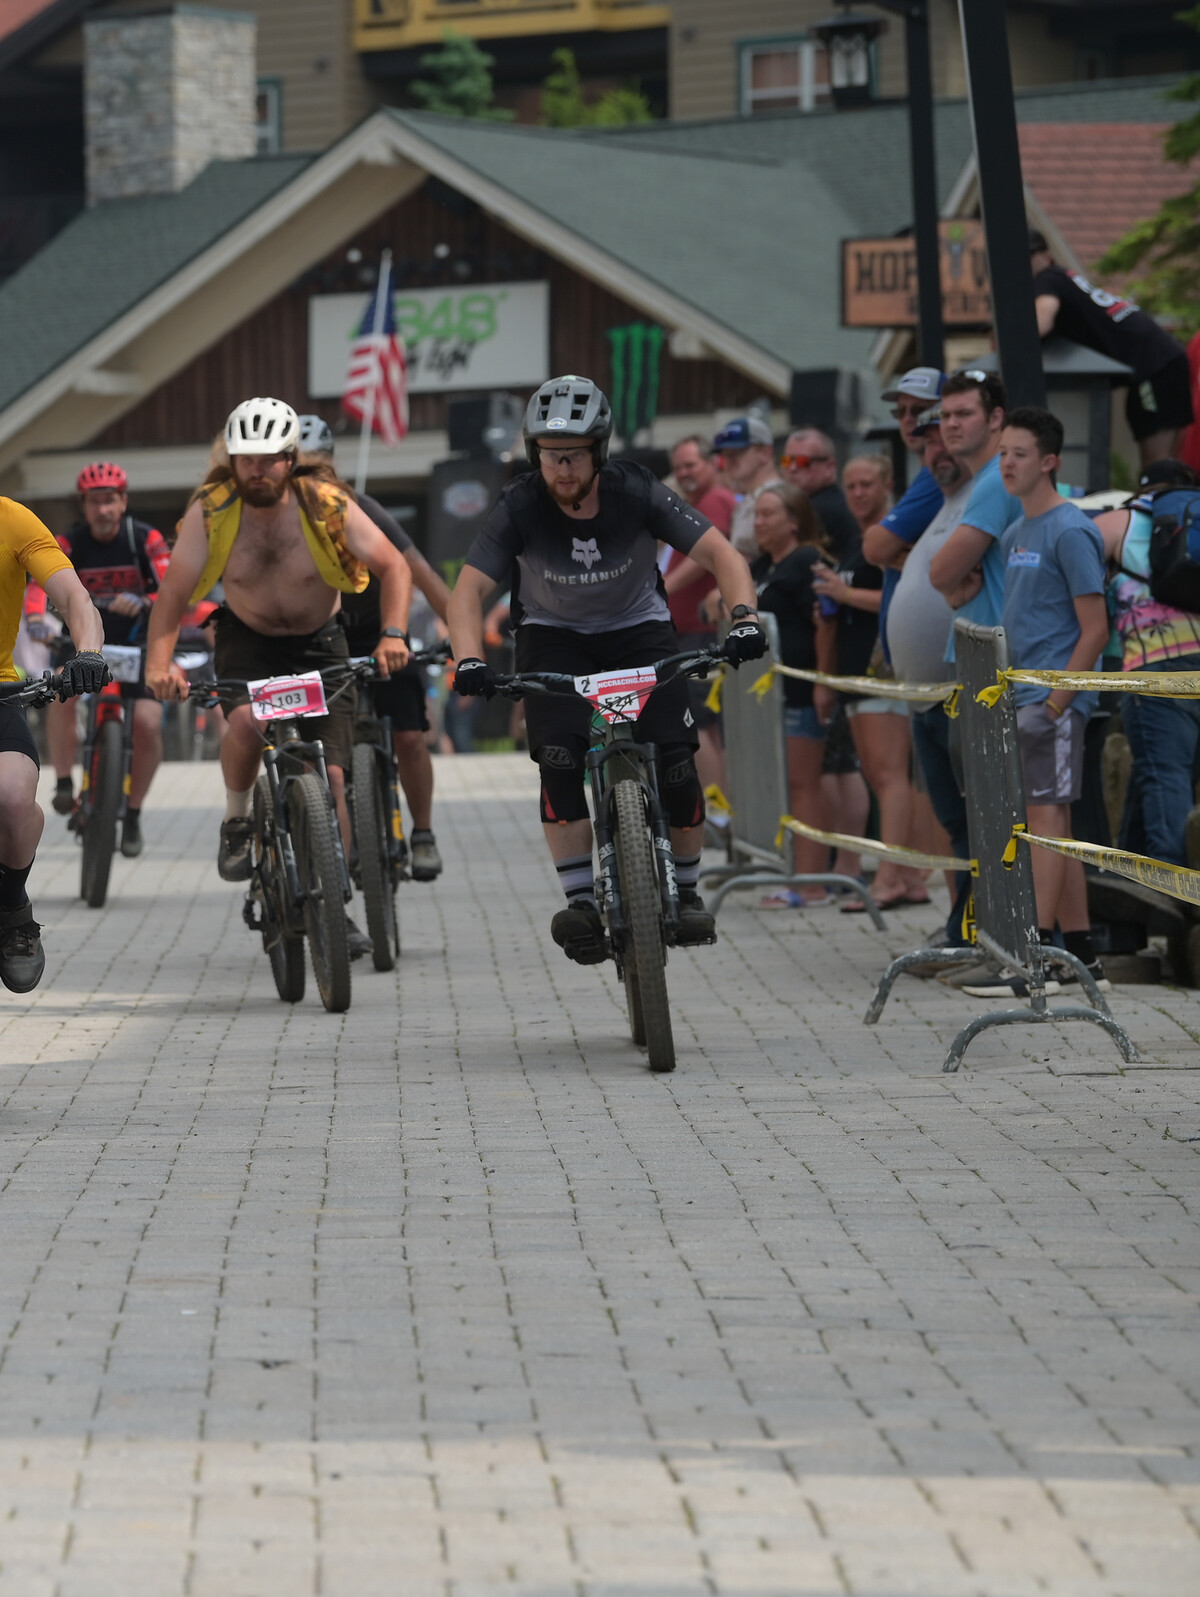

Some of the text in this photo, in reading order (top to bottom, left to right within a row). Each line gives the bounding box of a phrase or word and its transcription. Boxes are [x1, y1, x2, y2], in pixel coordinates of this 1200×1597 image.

[544, 569, 577, 585] RIDE
[277, 692, 302, 707] 103
[601, 865, 614, 903] FOX
[664, 858, 679, 897] FOX
